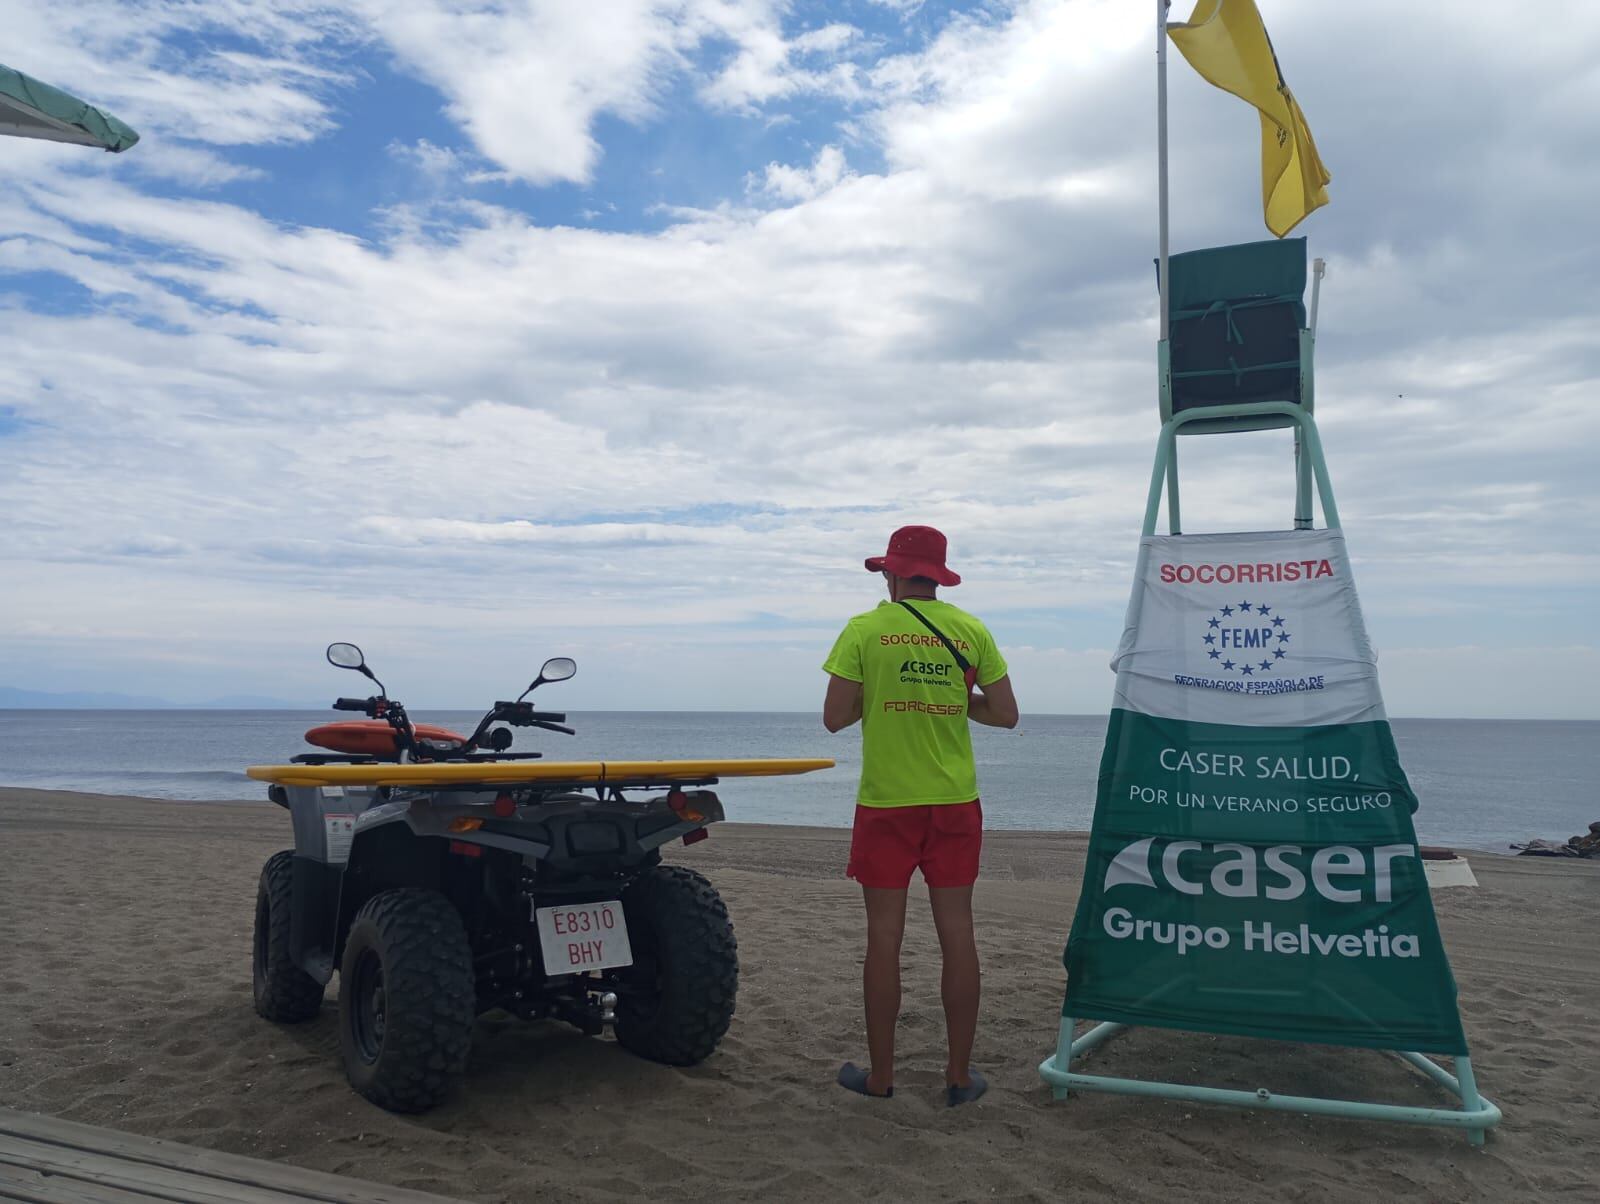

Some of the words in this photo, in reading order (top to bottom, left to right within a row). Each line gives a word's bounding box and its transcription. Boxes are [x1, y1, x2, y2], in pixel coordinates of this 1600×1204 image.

[1160, 559, 1334, 583] SOCORRISTA
[880, 634, 970, 651] SOCORRITA
[1221, 628, 1273, 649] FEMP
[900, 676, 922, 684] Grupo
[910, 661, 952, 676] caser
[1160, 748, 1245, 777] CASER
[1256, 755, 1360, 782] SALUD,
[1130, 785, 1168, 805] POR
[1176, 792, 1205, 809] UN
[1213, 795, 1299, 813] VERANO
[1307, 791, 1392, 813] SEGURO
[1162, 840, 1415, 903] caser
[554, 908, 615, 935] E8310
[1103, 906, 1230, 955] Grupo
[1244, 920, 1420, 958] Helvetia
[568, 940, 603, 965] BHY
